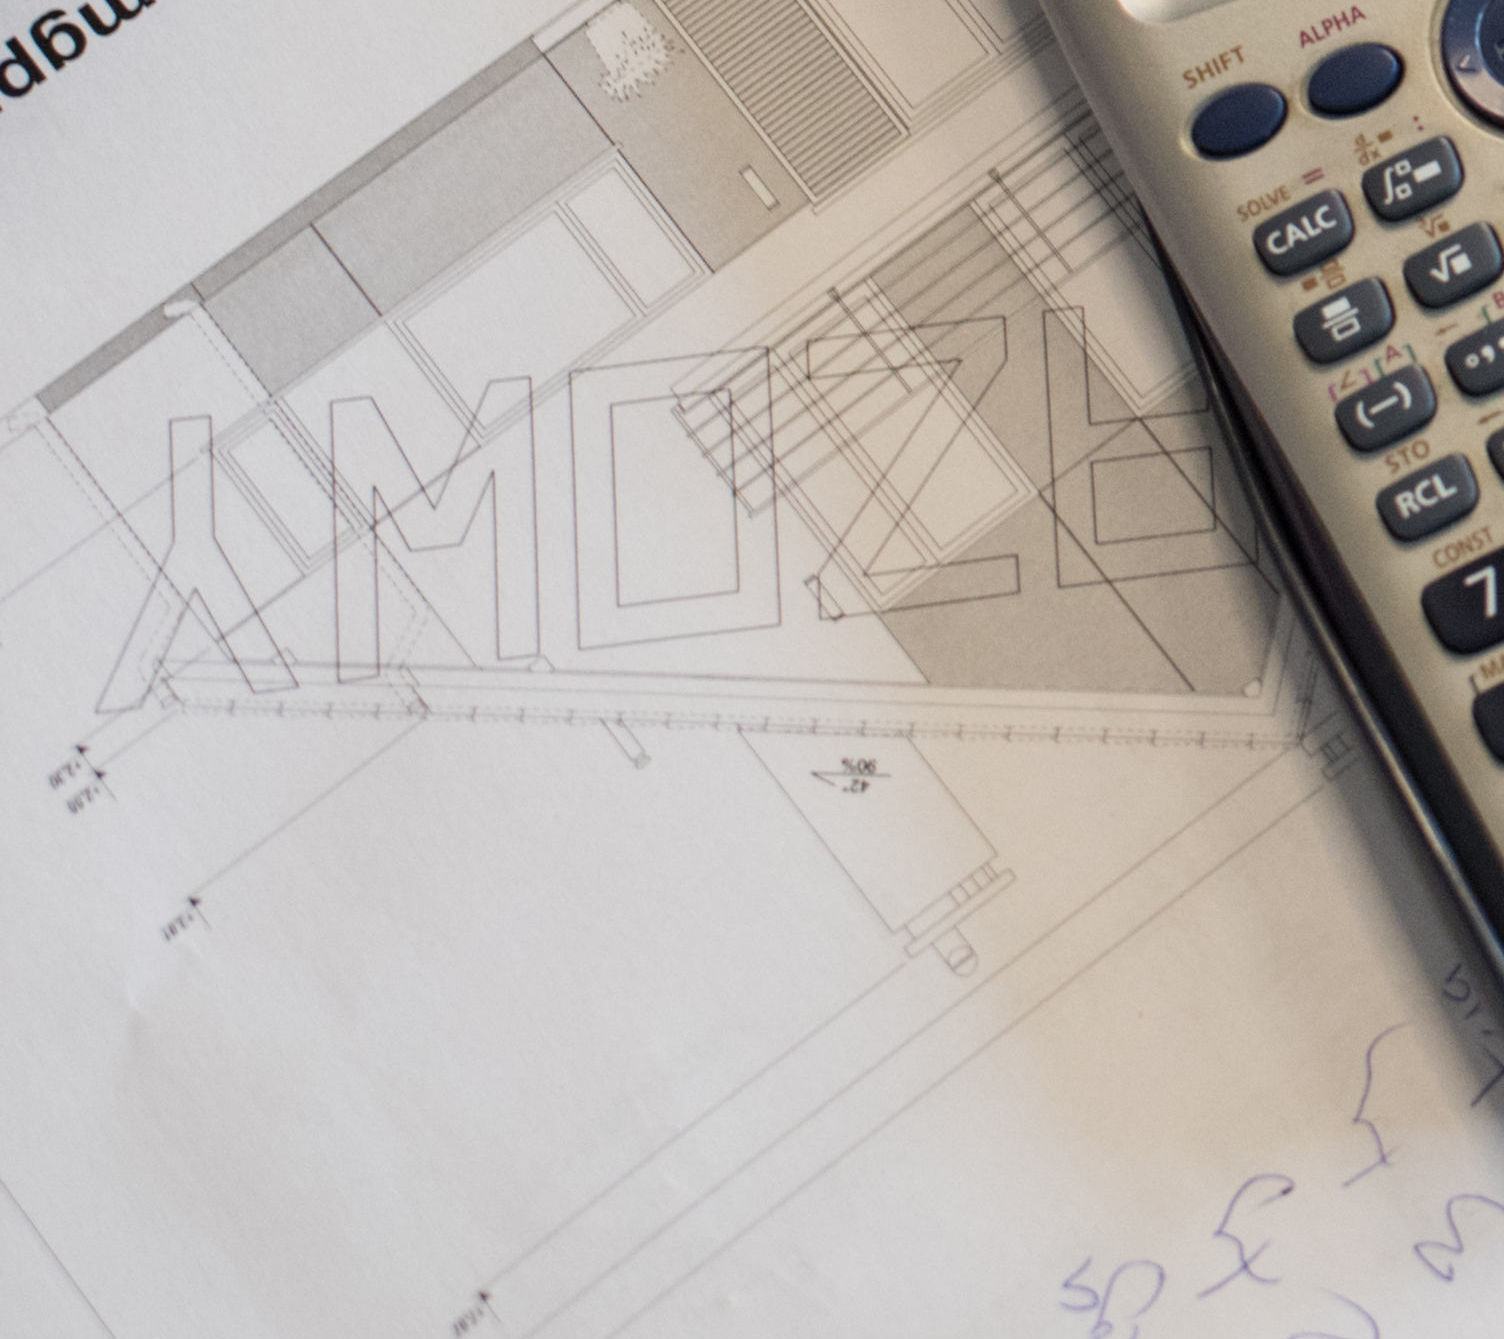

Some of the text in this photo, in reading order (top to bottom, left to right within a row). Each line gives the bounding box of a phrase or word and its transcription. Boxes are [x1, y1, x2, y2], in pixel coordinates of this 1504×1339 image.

[1298, 5, 1367, 49] ALPHA
[1181, 44, 1245, 90] SHIFT
[1236, 184, 1291, 222] SOLVE
[1266, 204, 1338, 255] CALC
[1394, 473, 1458, 520] RCL
[1431, 526, 1495, 569] CONST
[1464, 564, 1498, 619] 7
